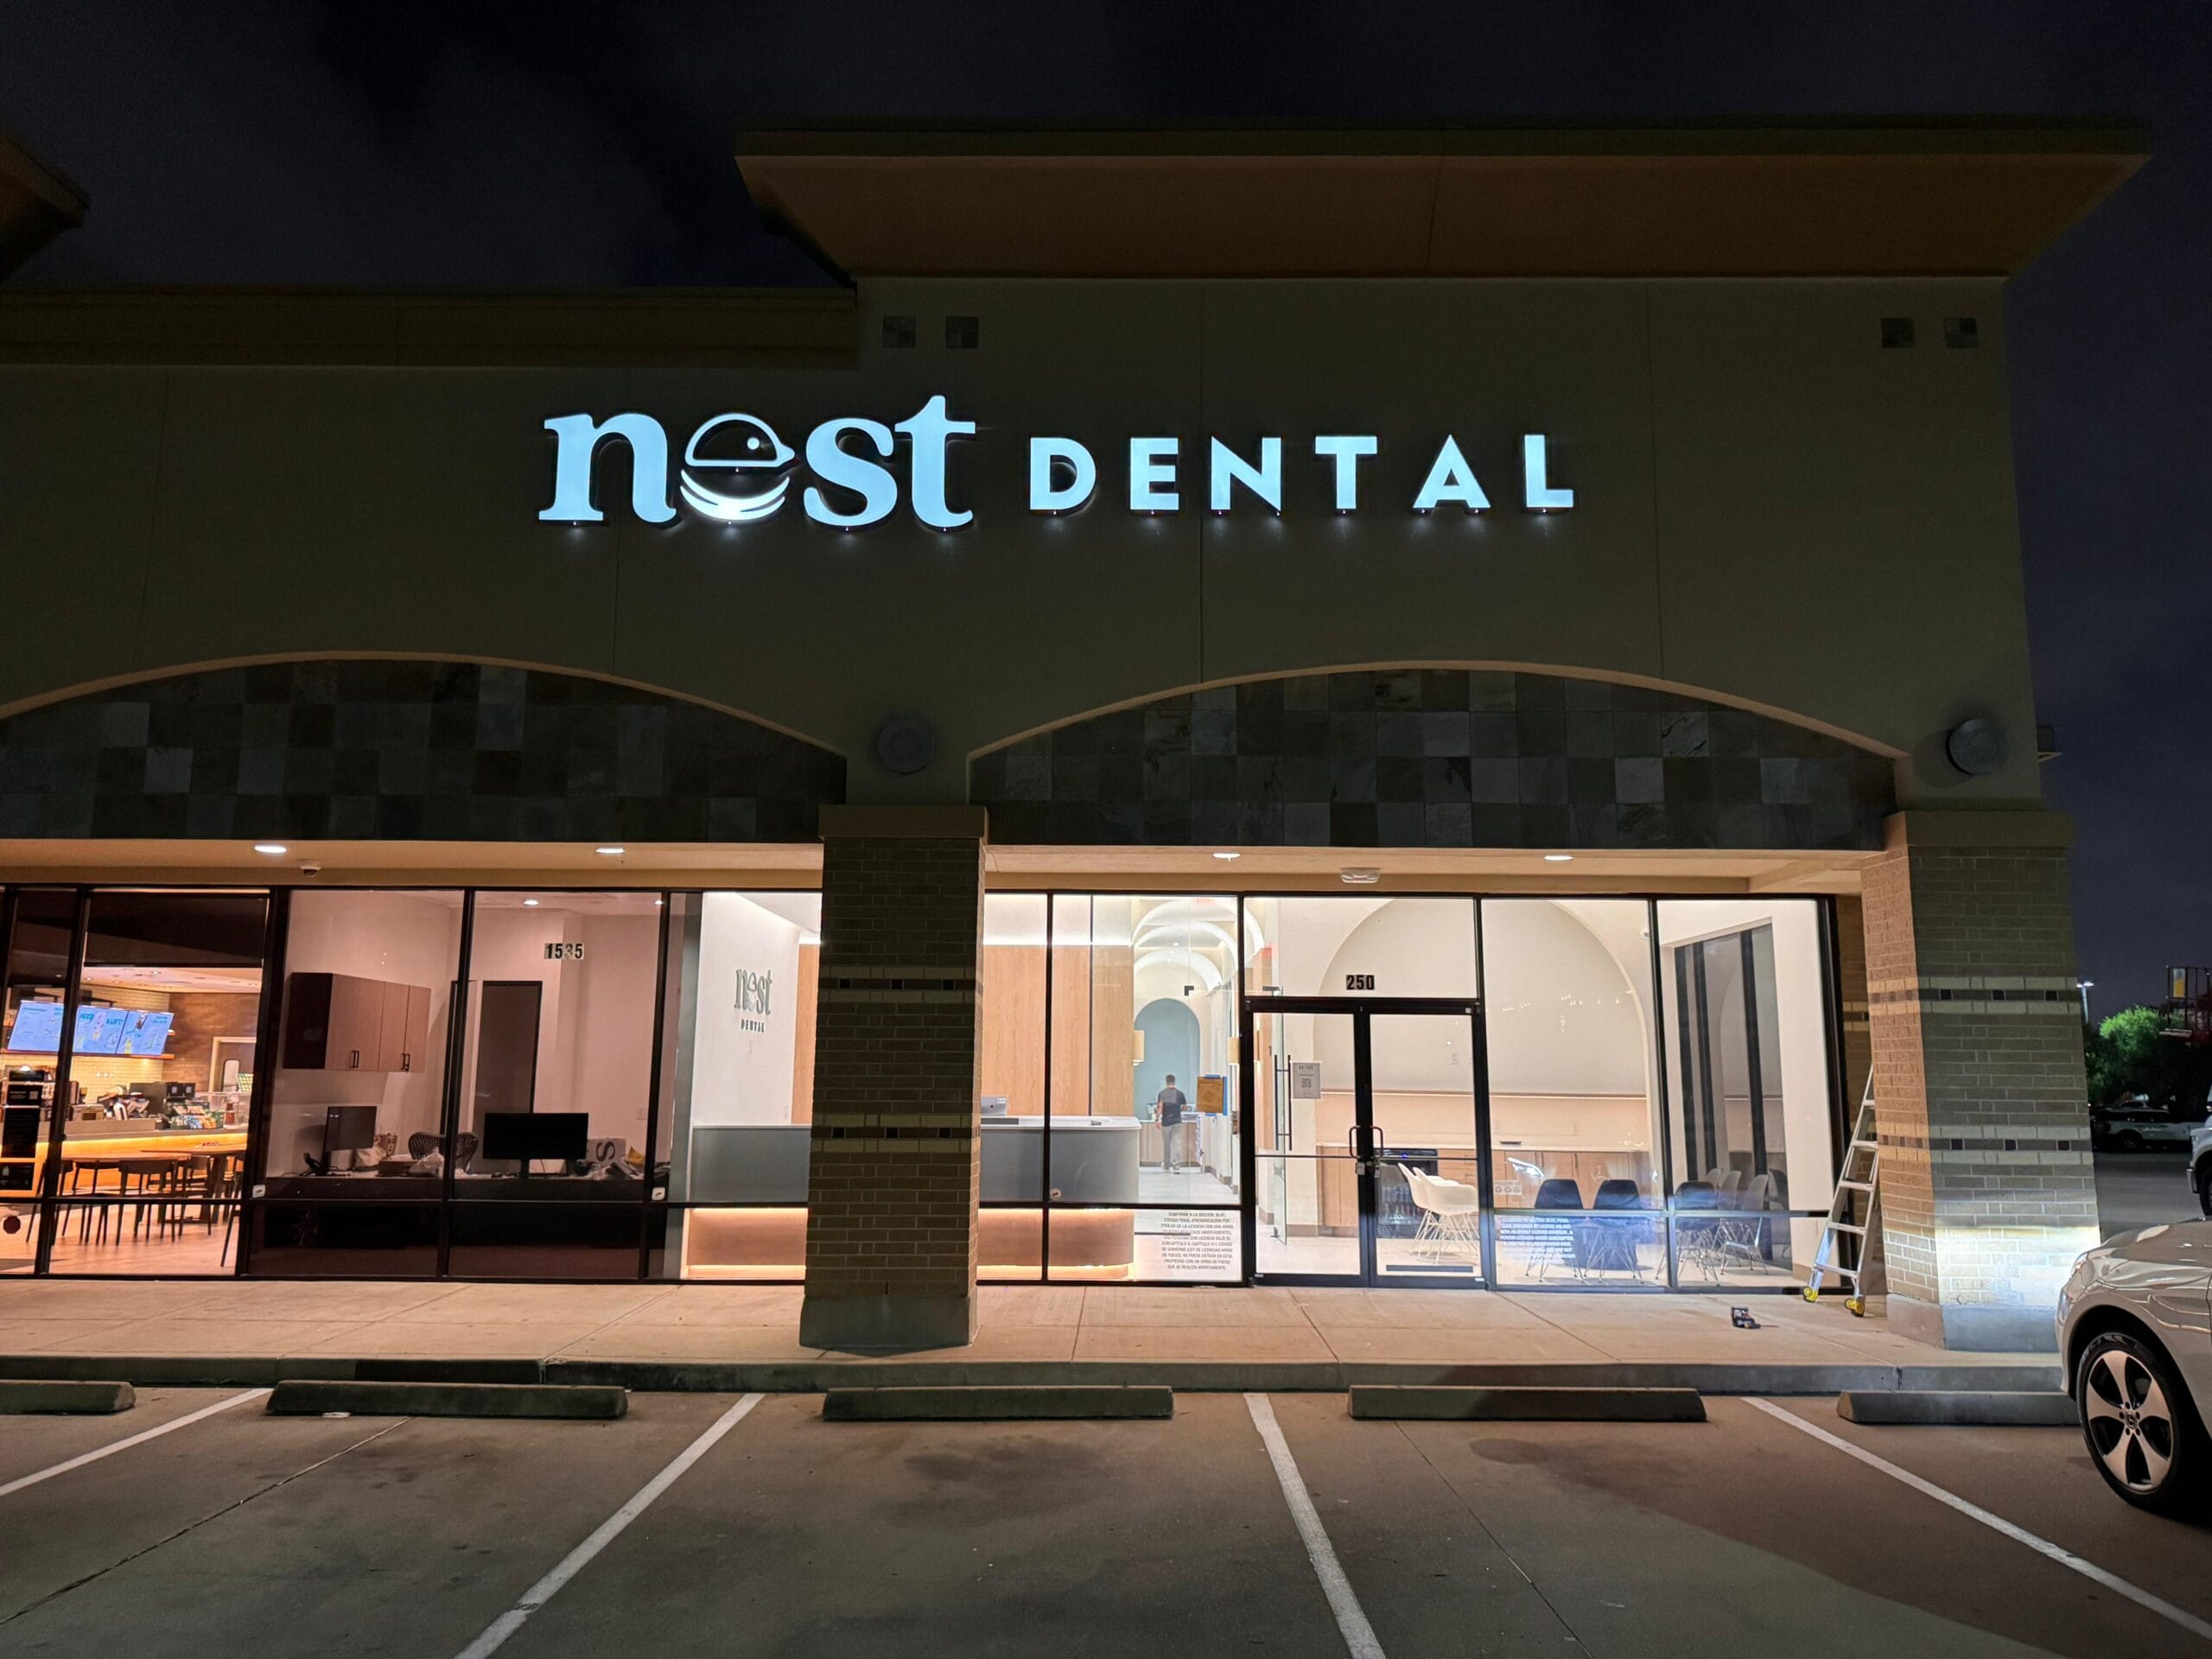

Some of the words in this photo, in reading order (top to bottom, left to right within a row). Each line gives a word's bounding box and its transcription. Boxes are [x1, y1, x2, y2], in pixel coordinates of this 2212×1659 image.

[538, 395, 976, 528] nest
[1030, 434, 1573, 511] DENTAL
[734, 969, 772, 1015] nest
[1346, 975, 1375, 990] 250
[741, 1019, 765, 1033] DENTAL
